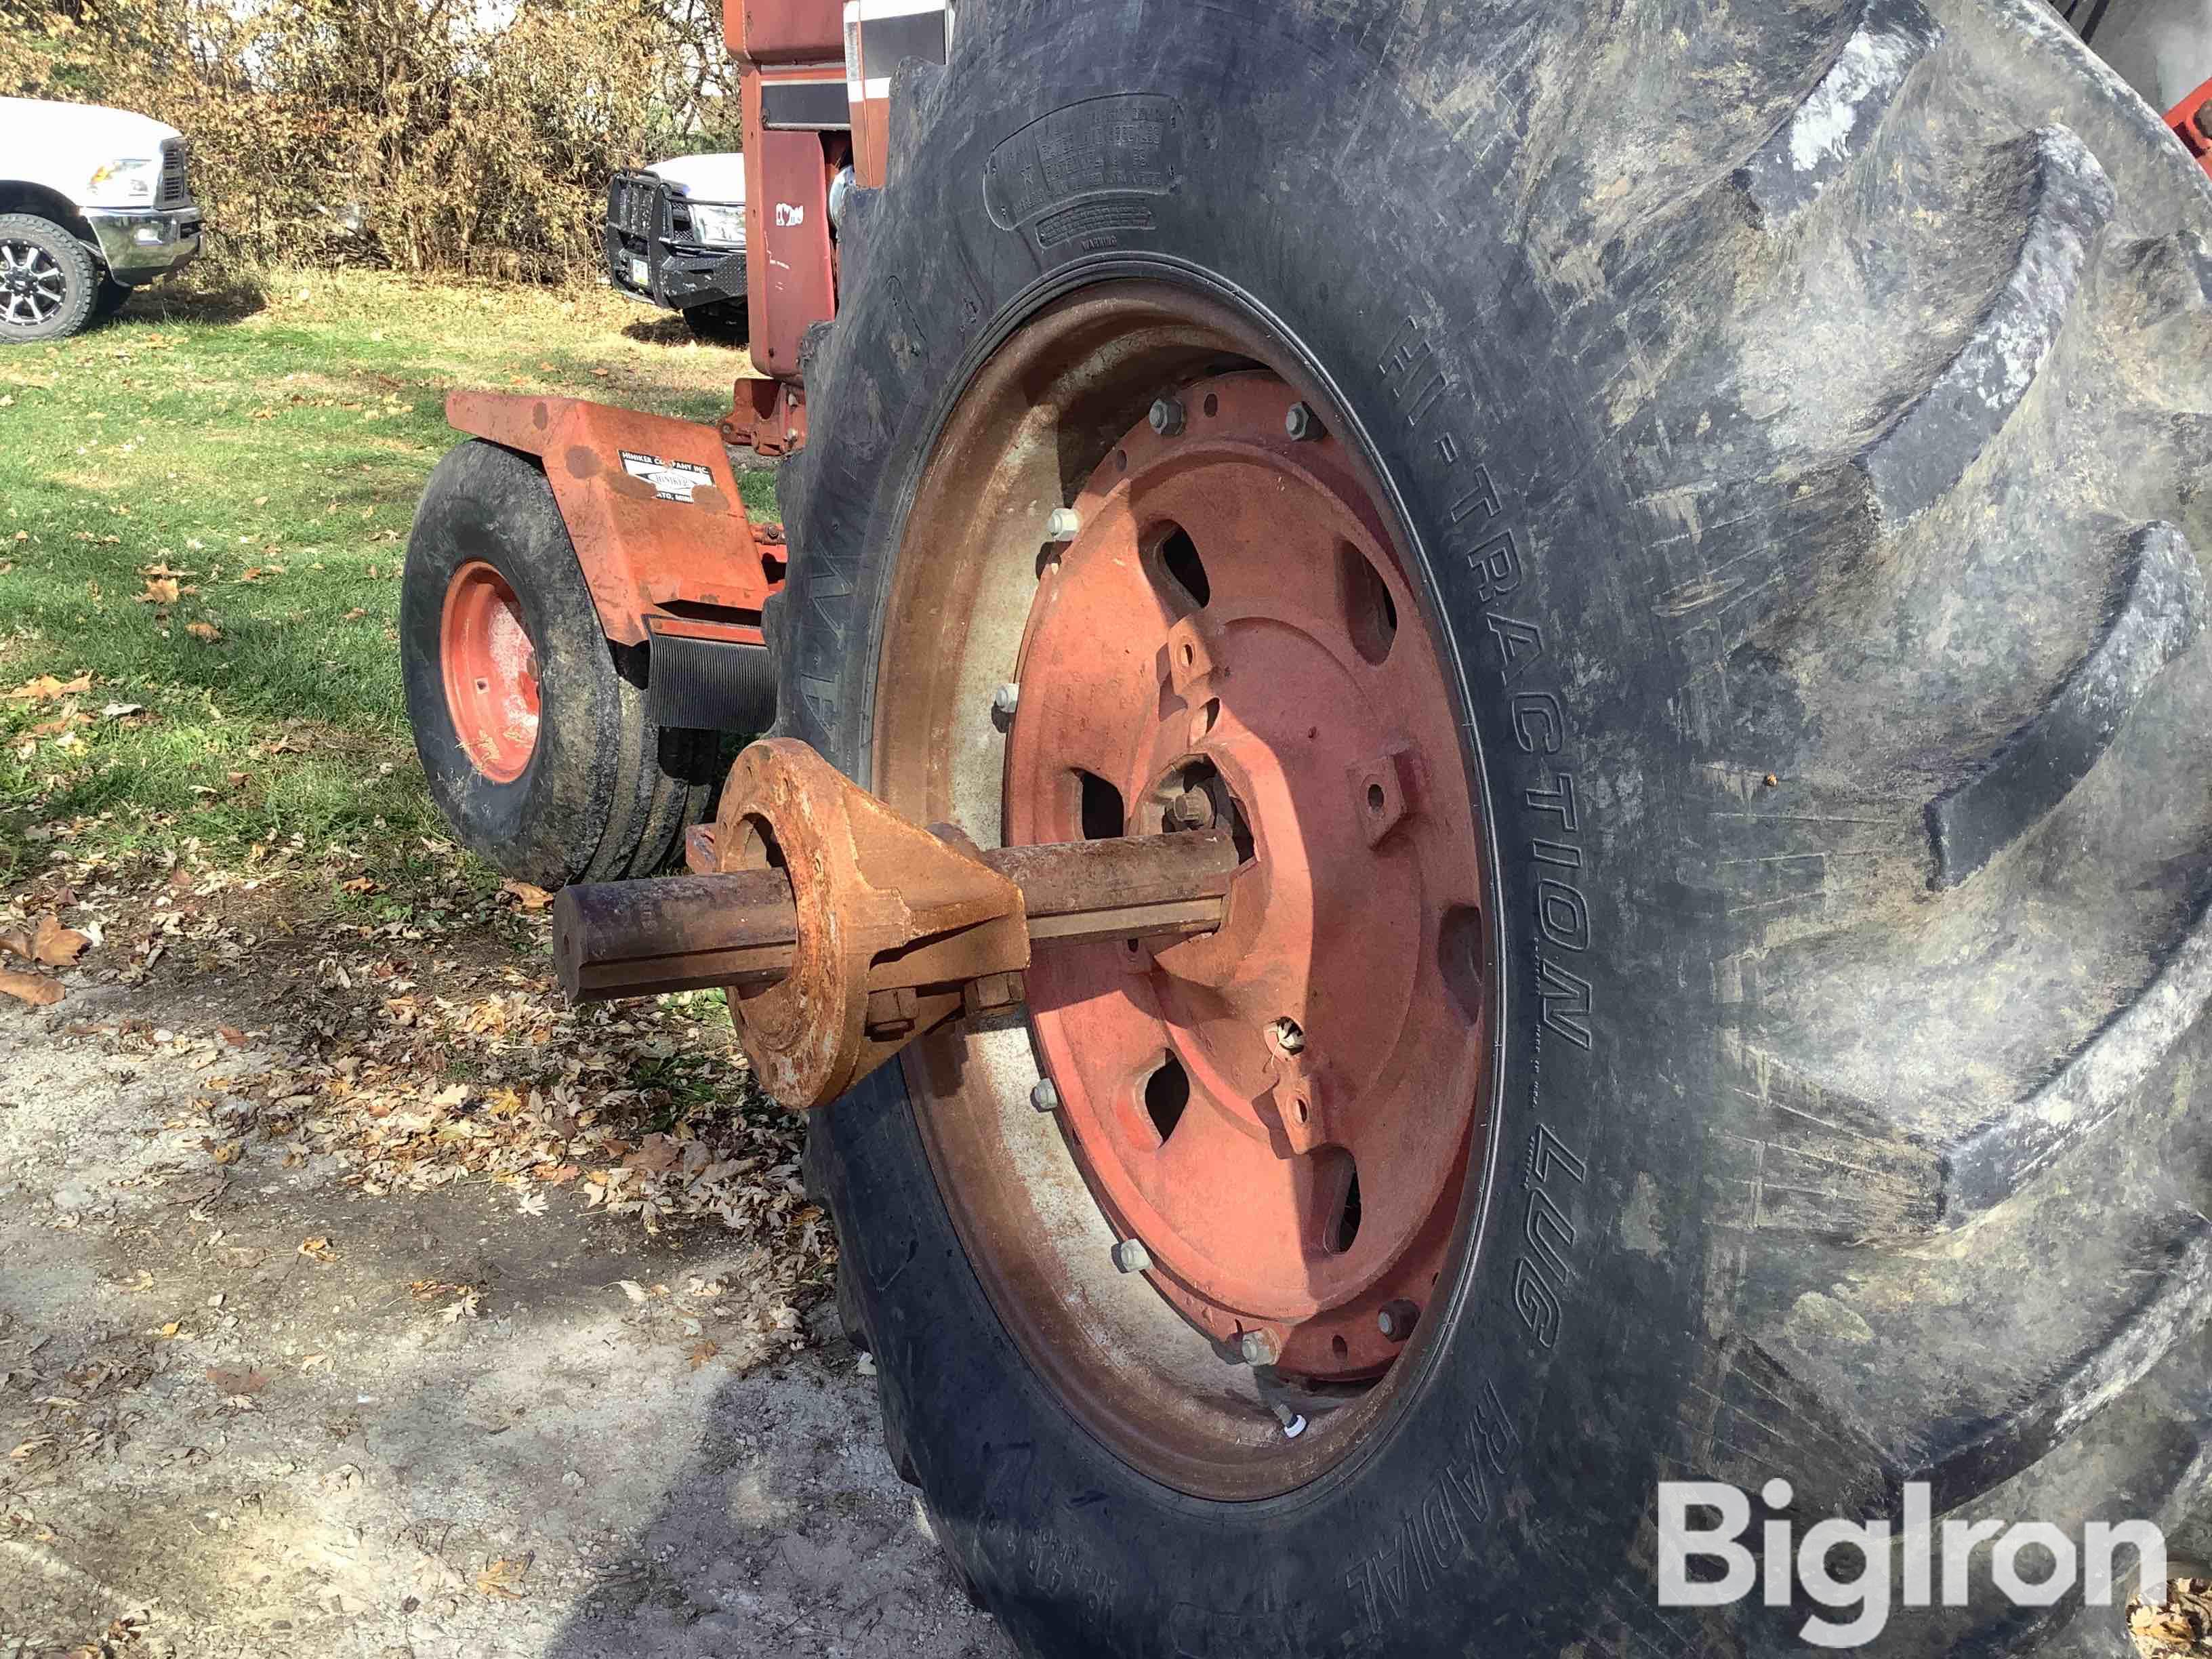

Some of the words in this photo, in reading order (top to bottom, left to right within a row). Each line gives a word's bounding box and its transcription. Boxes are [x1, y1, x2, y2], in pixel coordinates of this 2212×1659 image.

[622, 451, 653, 464] HINIKER
[654, 457, 691, 471] COPANY
[1512, 1122, 1587, 1350] LUG
[1345, 1378, 1521, 1635] RADIAL
